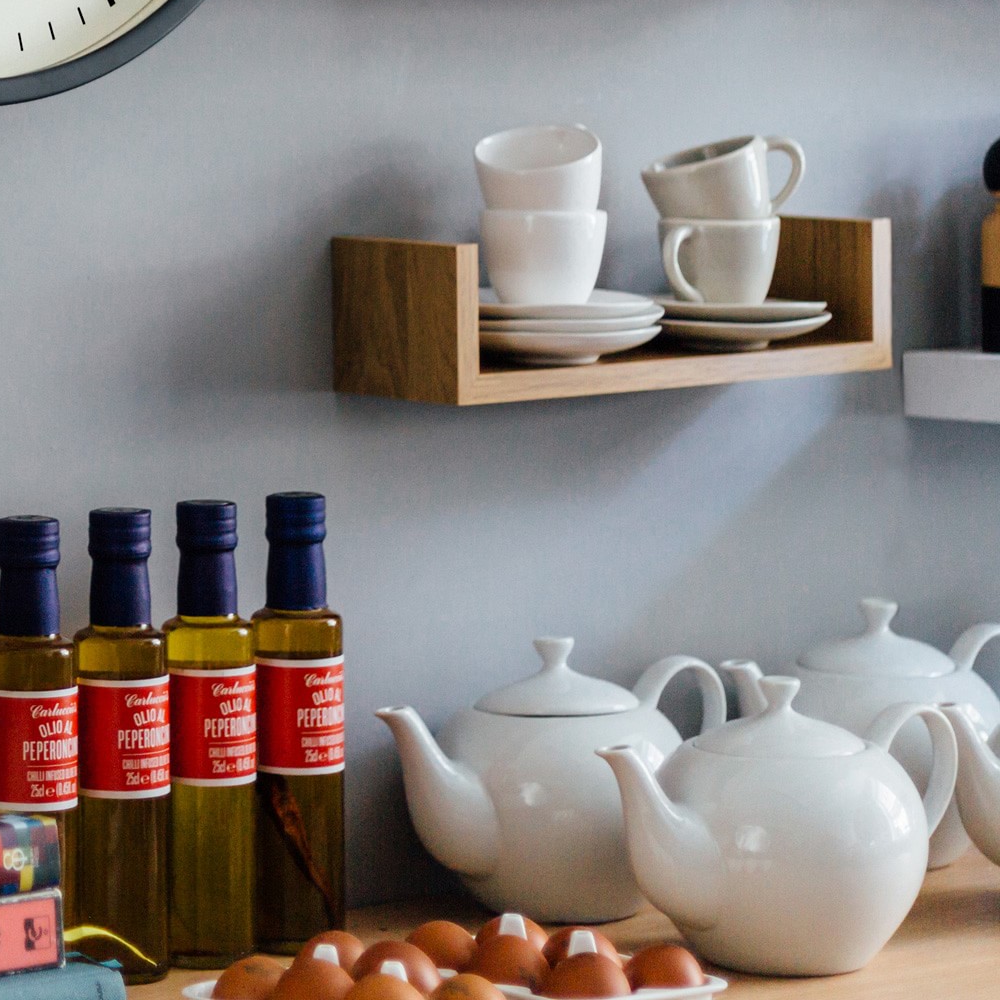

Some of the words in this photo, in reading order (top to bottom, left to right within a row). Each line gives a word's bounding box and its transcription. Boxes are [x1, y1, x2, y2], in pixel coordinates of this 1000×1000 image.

[311, 687, 334, 705] OLIO
[219, 697, 242, 716] OLIO
[133, 708, 156, 727] OLIO
[38, 719, 63, 738] OLIO
